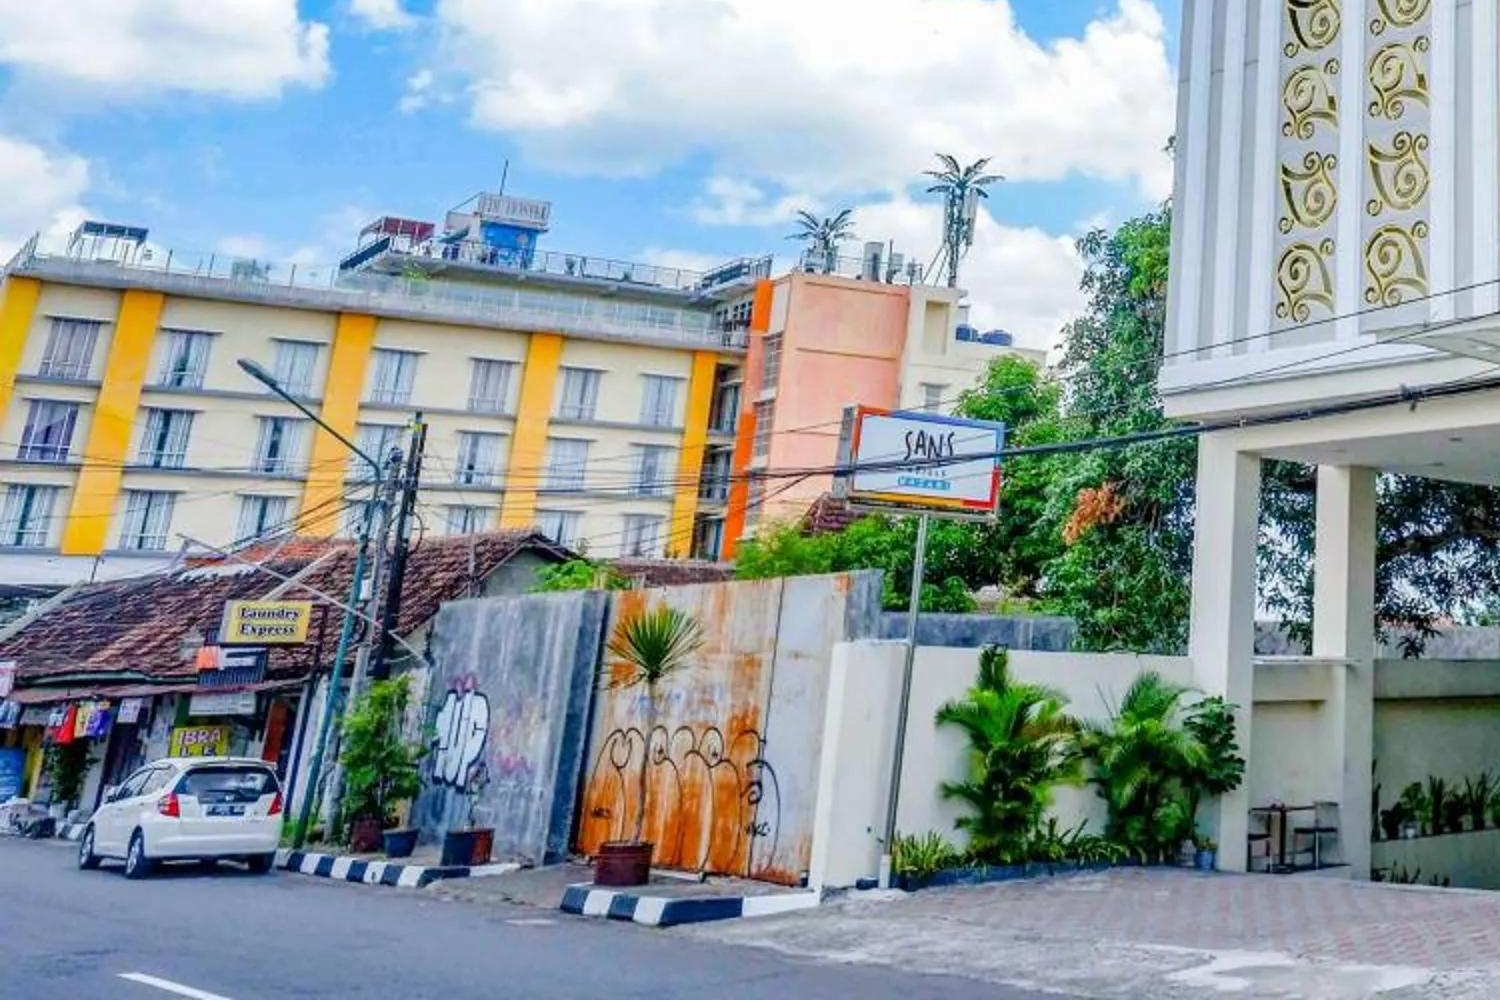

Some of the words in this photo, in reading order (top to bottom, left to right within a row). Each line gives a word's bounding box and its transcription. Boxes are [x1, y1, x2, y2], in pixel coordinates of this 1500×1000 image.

[903, 429, 955, 461] SANS
[241, 607, 299, 622] Laundry
[241, 624, 296, 637] Express
